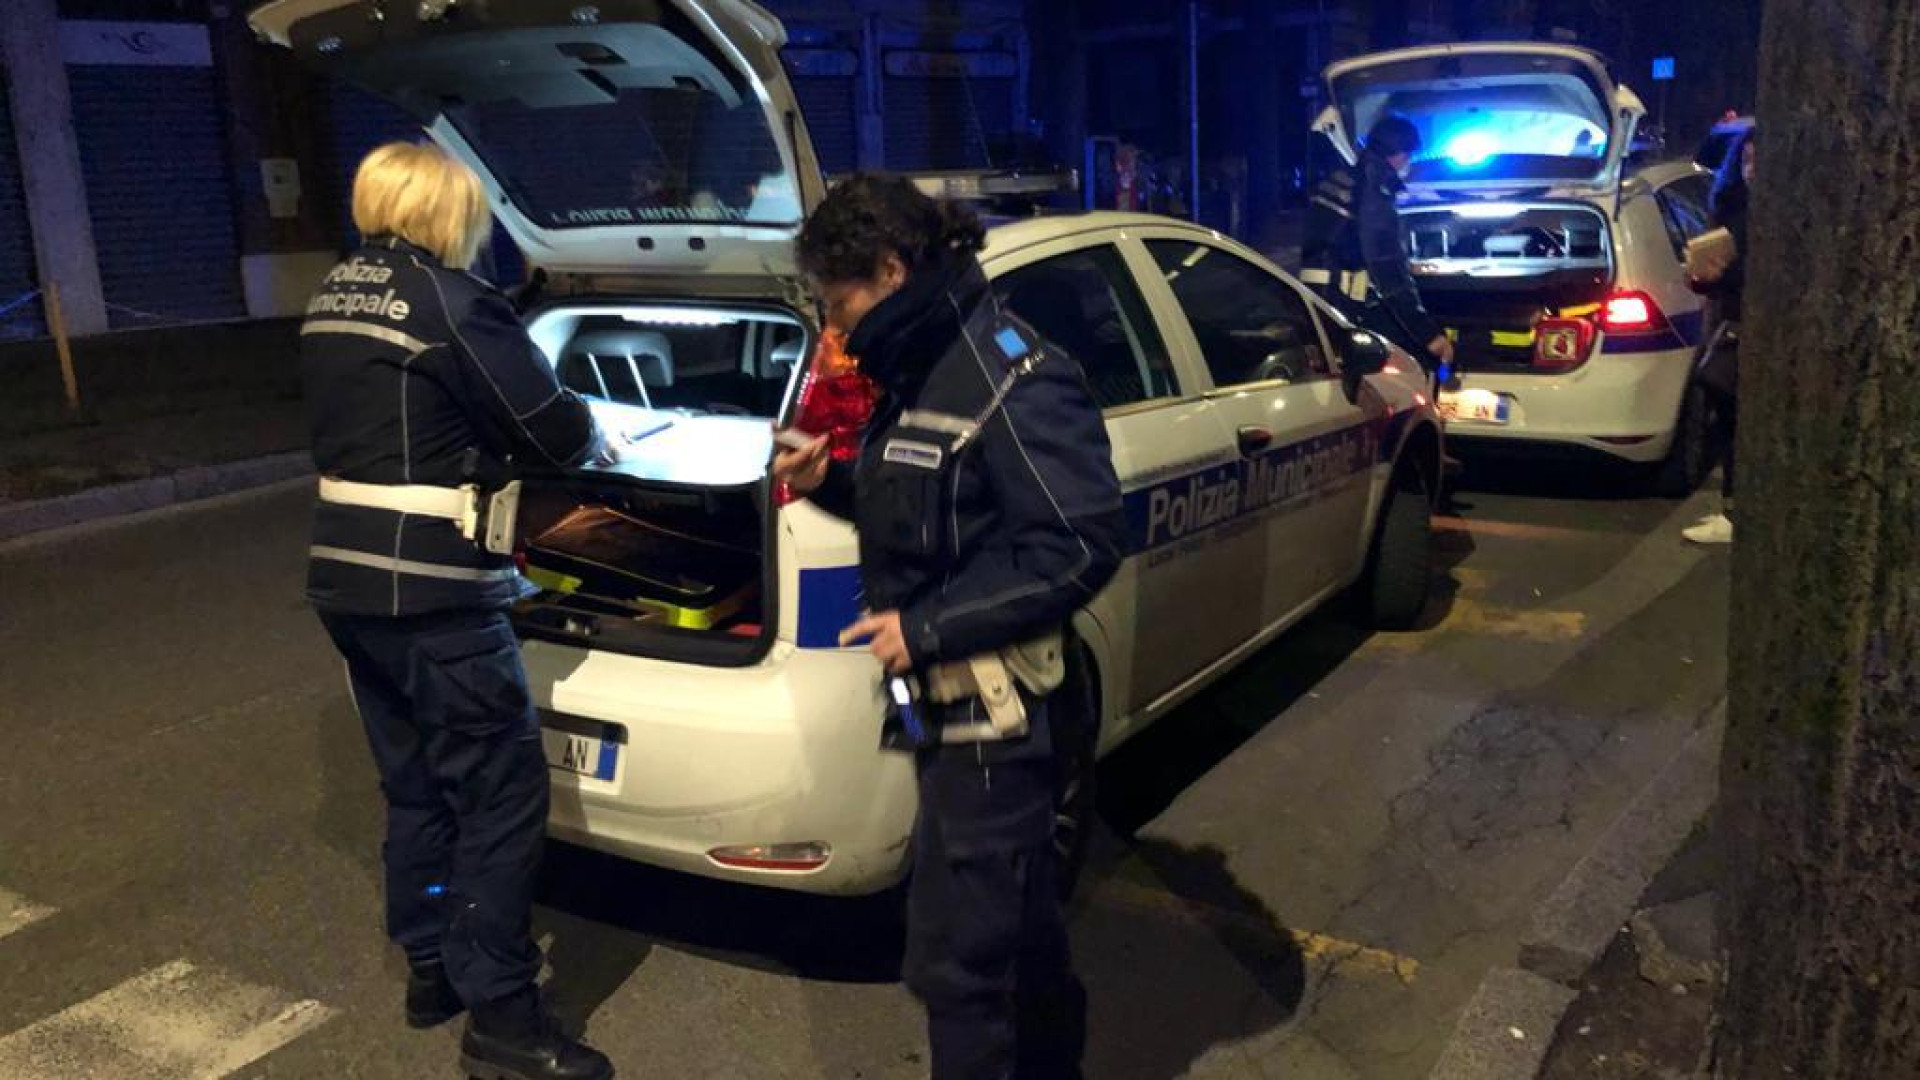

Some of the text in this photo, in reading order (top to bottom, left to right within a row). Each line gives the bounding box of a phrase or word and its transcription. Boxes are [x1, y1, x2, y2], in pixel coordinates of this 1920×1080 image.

[306, 284, 409, 320] unicipale
[1147, 470, 1241, 545] Polizia
[564, 738, 588, 769] AN
